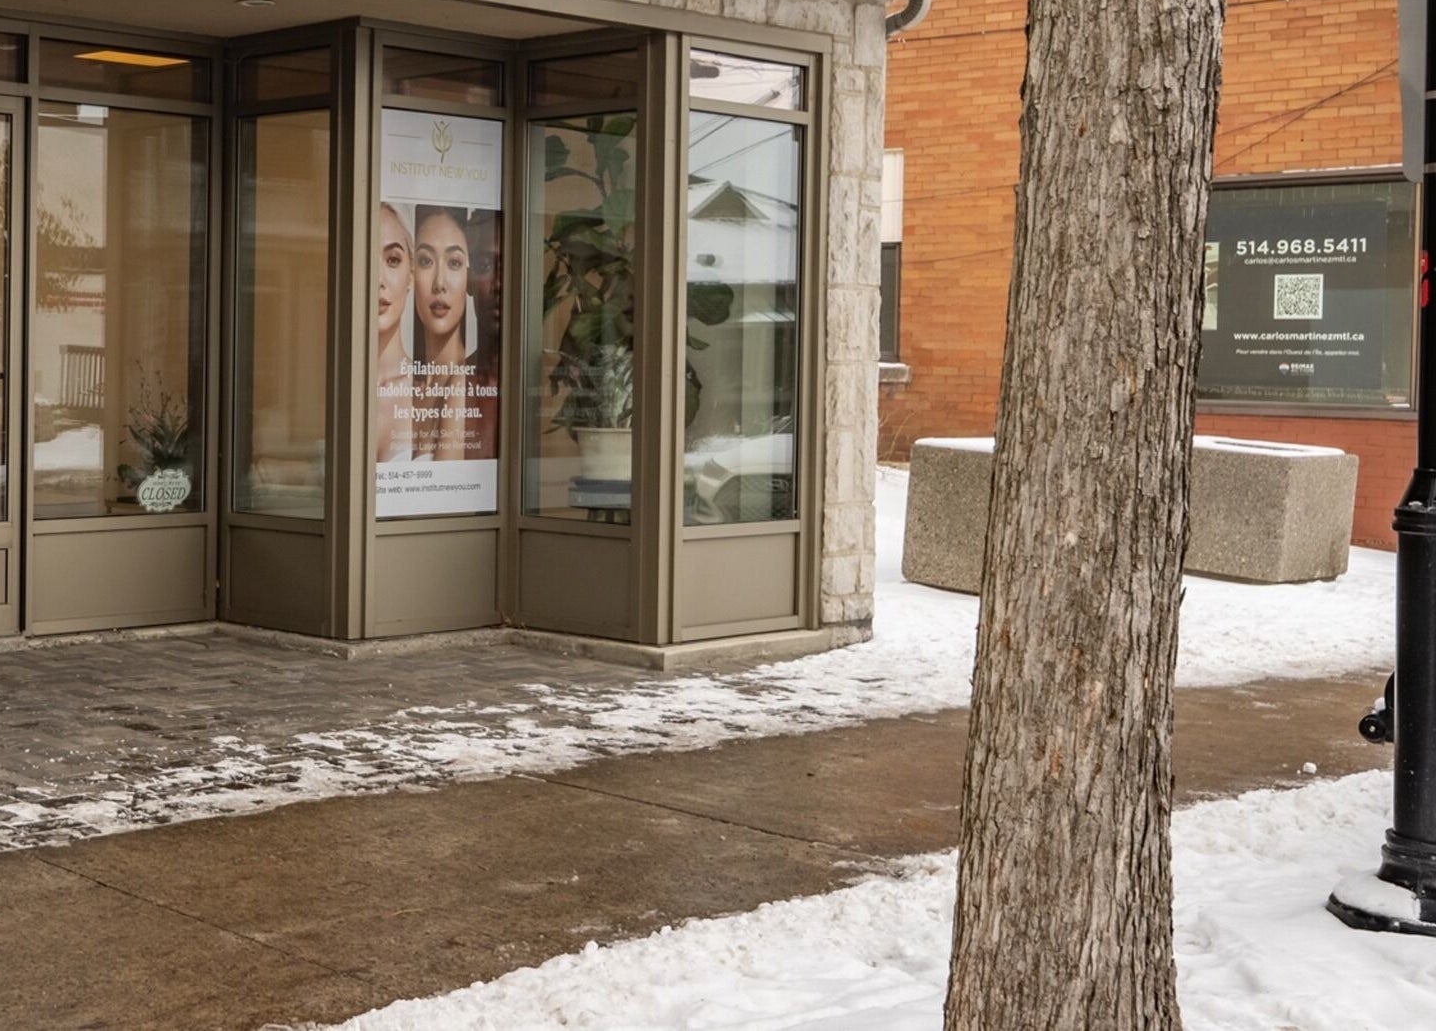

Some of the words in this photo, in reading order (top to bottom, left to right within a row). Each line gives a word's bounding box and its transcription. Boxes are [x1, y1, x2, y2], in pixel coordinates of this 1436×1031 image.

[390, 161, 437, 178] INSTITUT
[438, 165, 465, 179] NEW
[466, 167, 488, 181] YOU
[1236, 238, 1367, 255] 514.968.5411
[1234, 331, 1365, 341] www.carlosmartinezmtl.ca
[400, 358, 450, 378] Épilation
[450, 361, 477, 376] laser
[467, 382, 475, 397] à
[476, 384, 498, 397] tous
[393, 404, 409, 419] les
[411, 406, 440, 422] types
[440, 404, 454, 419] de
[454, 406, 483, 421] peau.
[142, 486, 186, 500] CLOSED
